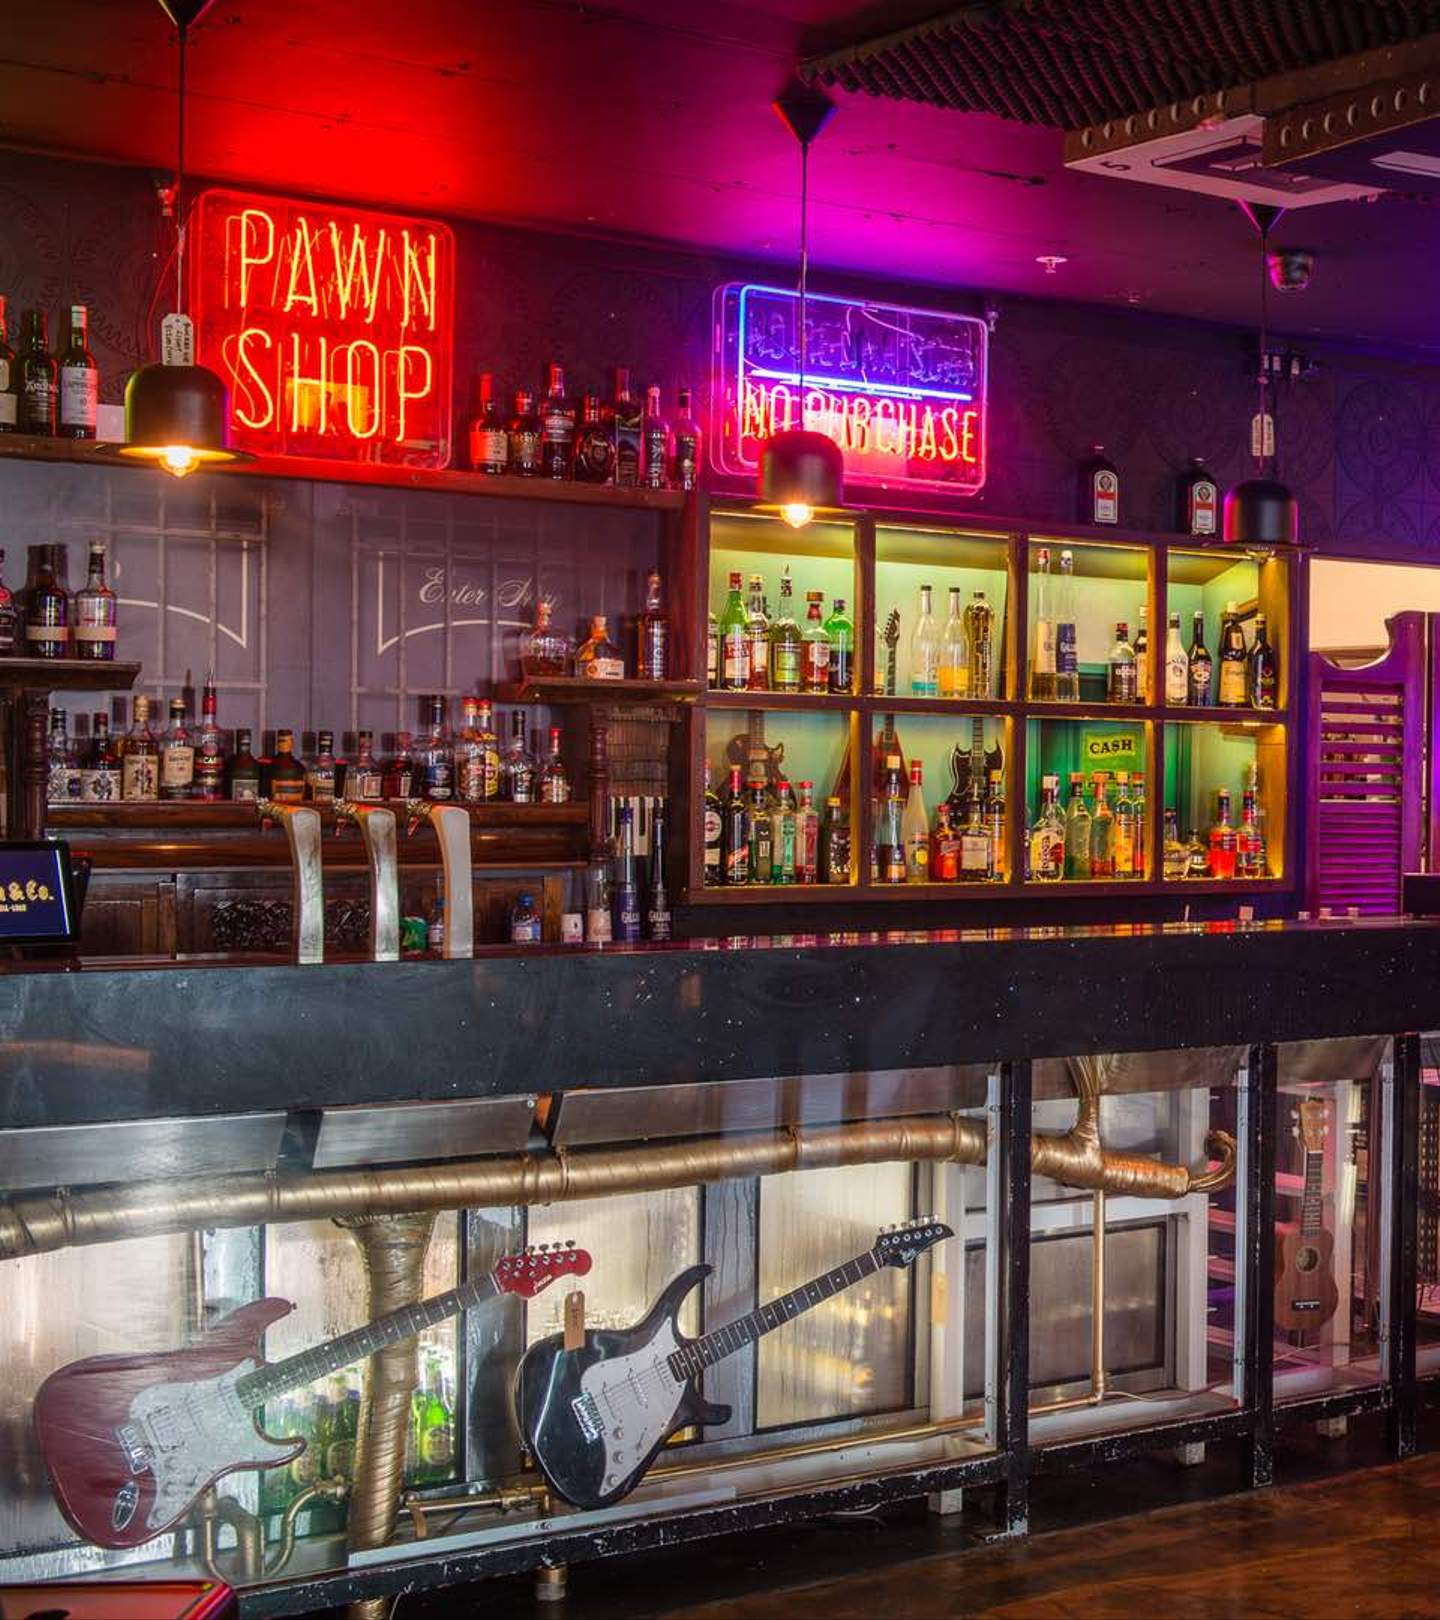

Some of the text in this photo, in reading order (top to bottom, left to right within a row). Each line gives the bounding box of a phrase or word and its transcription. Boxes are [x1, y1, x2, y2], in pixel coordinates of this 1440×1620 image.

[240, 209, 437, 330] PAWN
[236, 328, 432, 441] SHOP
[742, 383, 791, 439] NO
[1090, 738, 1132, 754] CASH
